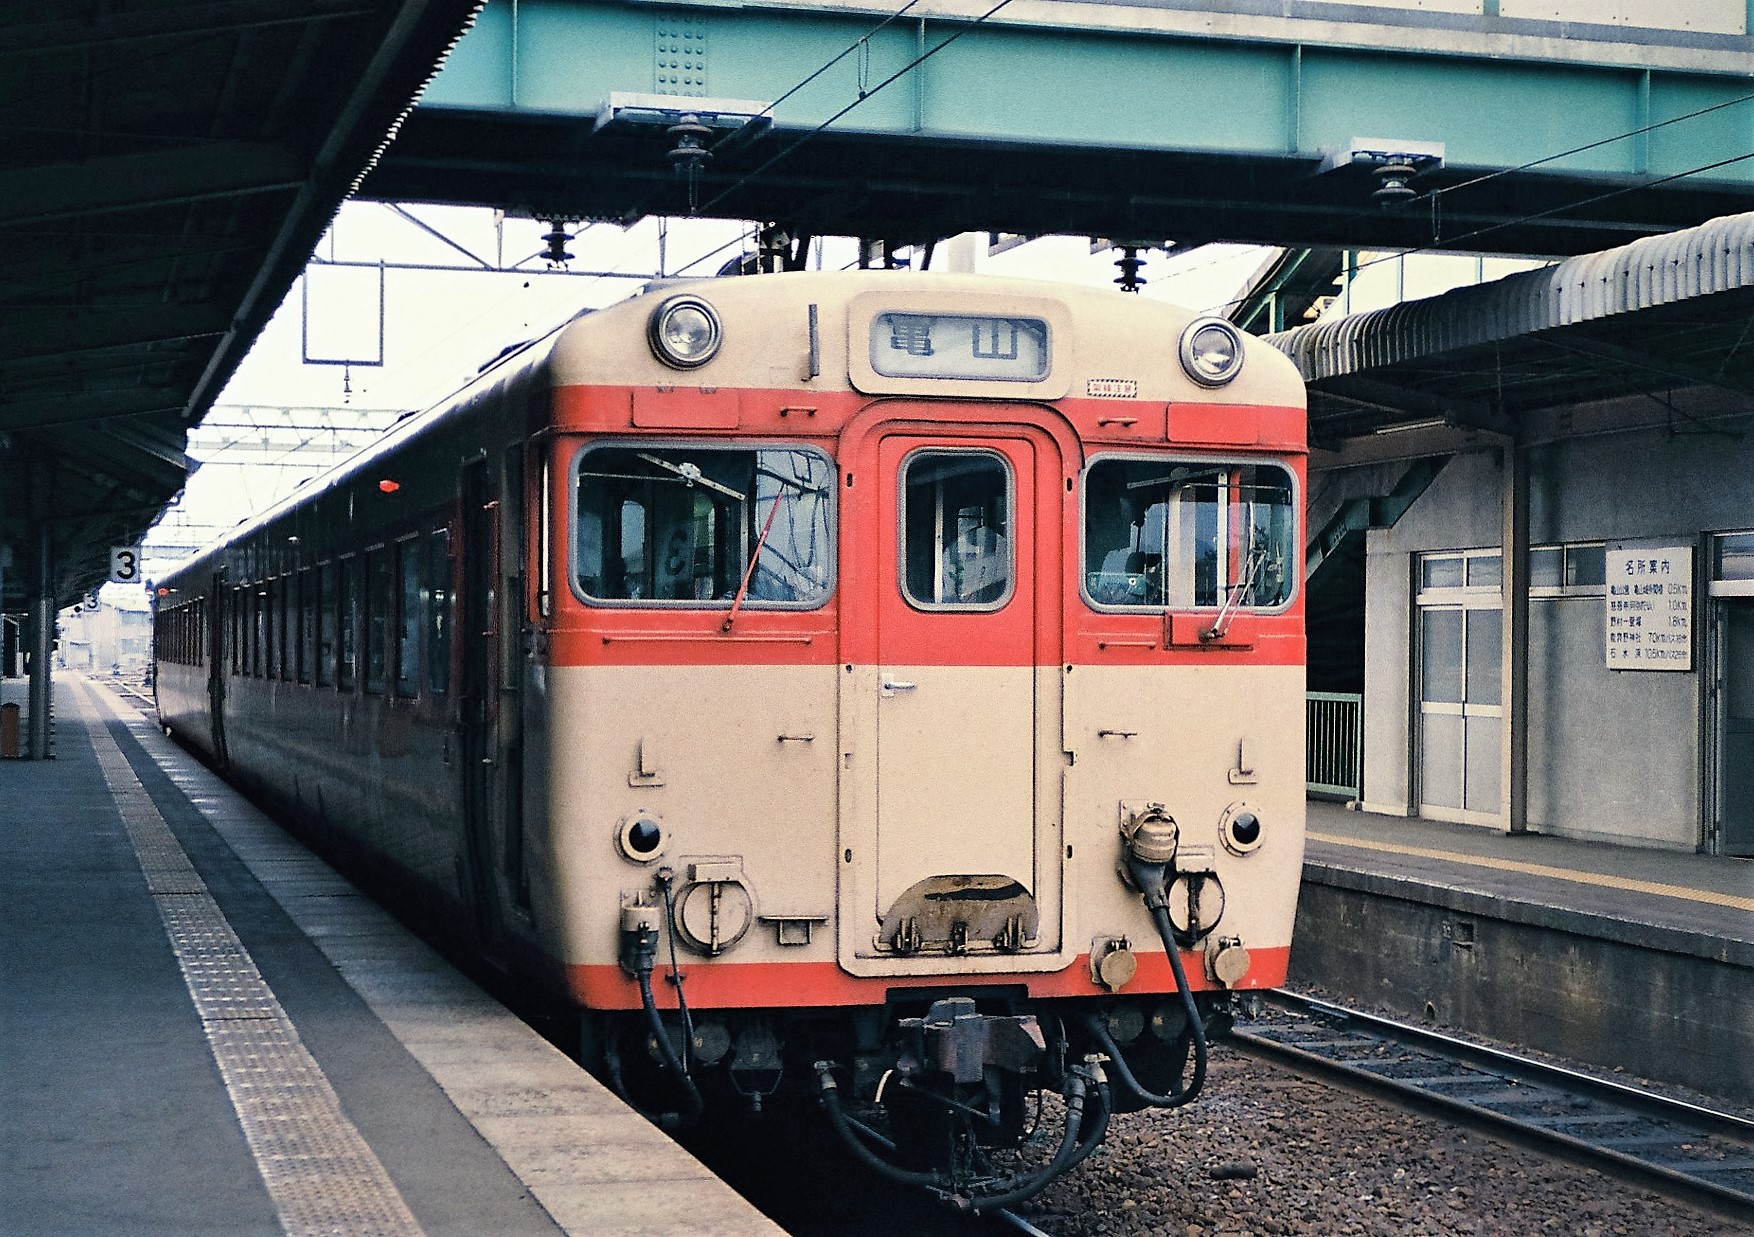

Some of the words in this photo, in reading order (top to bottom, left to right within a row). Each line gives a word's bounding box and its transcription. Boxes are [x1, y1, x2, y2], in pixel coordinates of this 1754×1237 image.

[116, 551, 136, 580] 3
[1625, 559, 1670, 576] 名所案内
